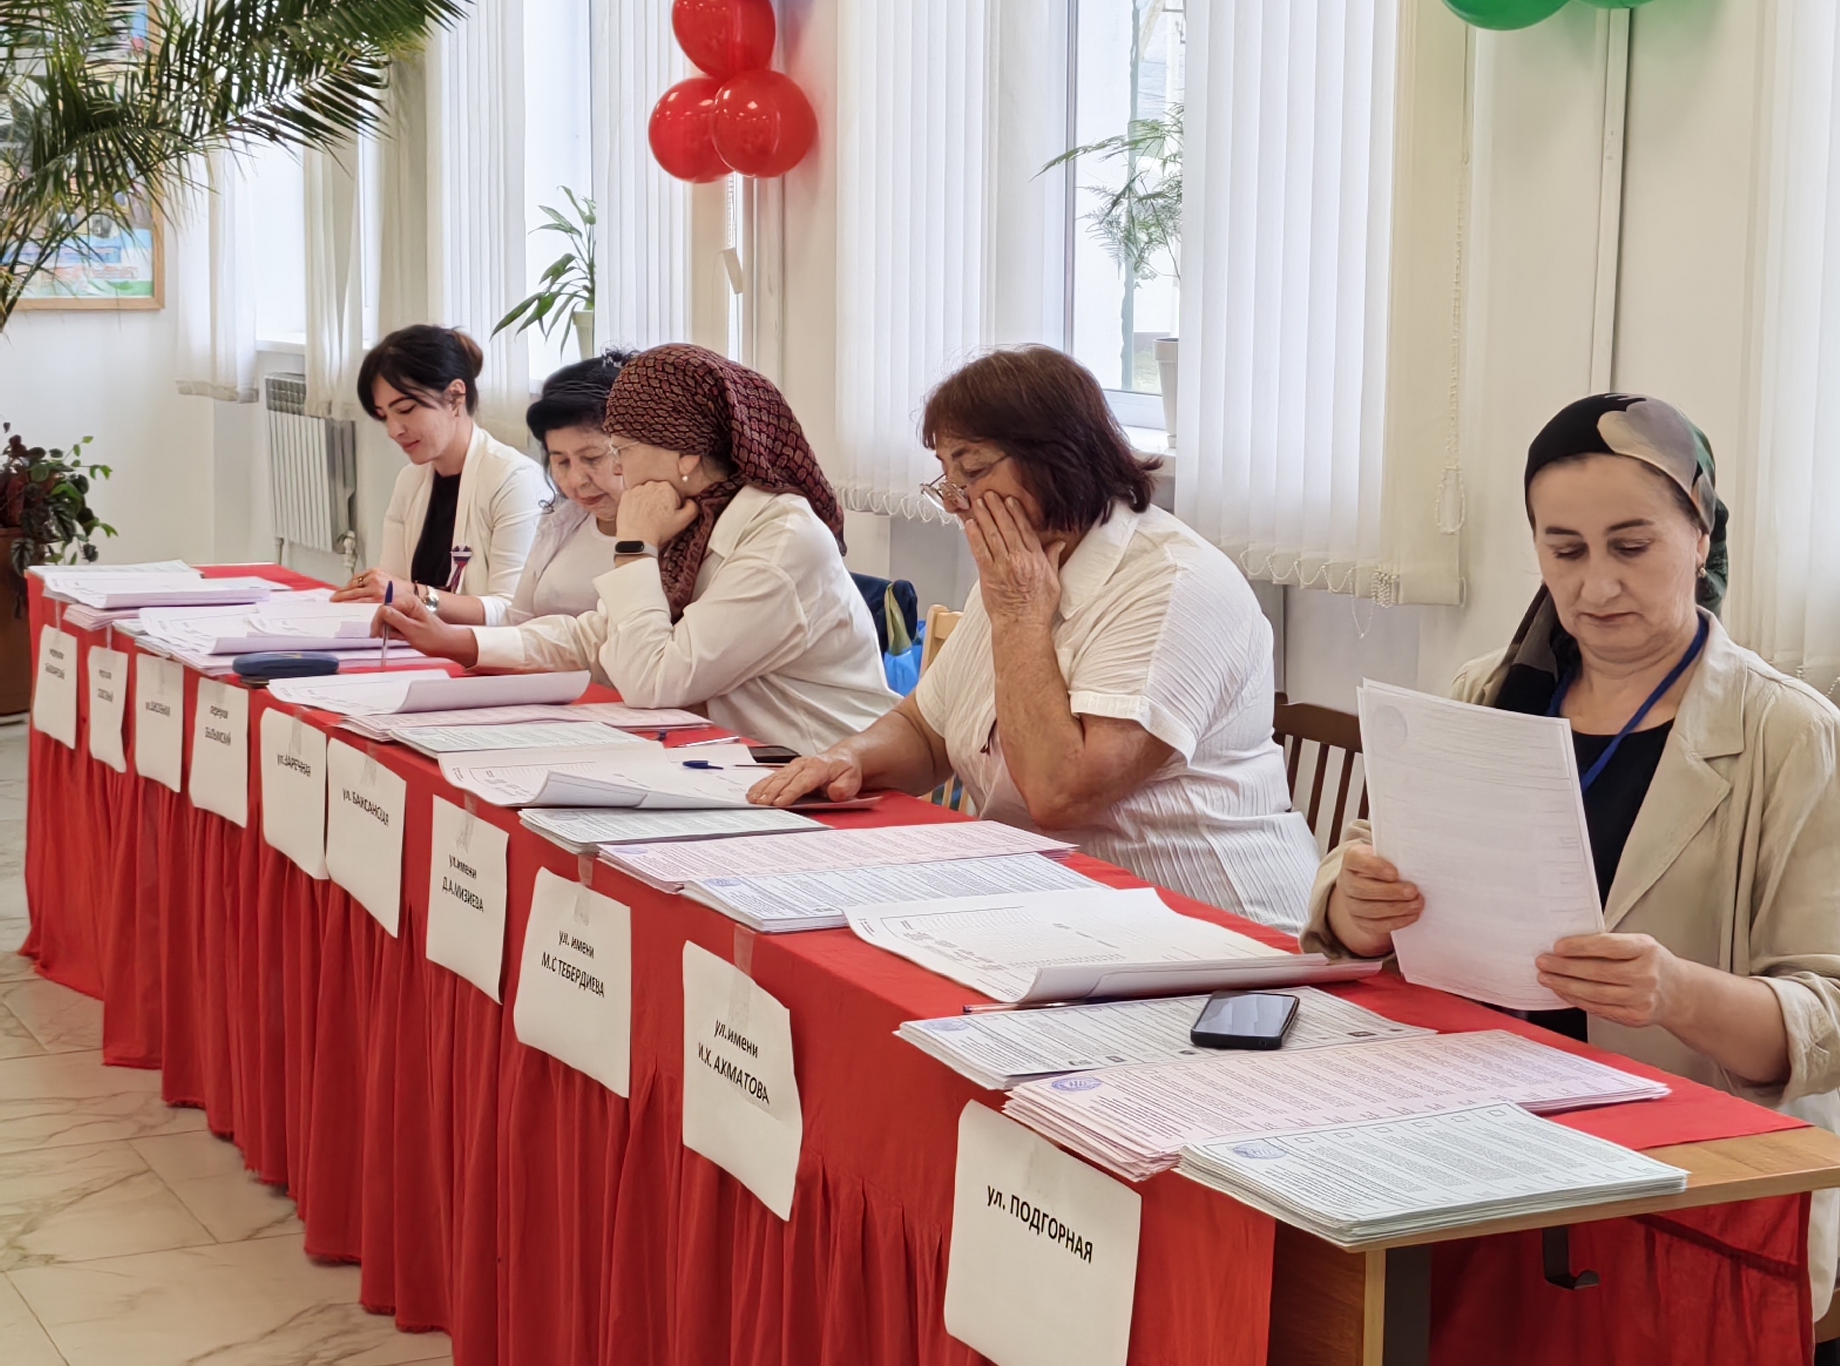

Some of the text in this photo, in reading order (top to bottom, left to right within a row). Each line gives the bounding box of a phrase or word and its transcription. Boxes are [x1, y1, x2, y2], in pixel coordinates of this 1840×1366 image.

[570, 936, 595, 960] имени
[713, 1055, 770, 1105] АХМАТОВА
[987, 1185, 1093, 1264] ул. ПОДГОРНАЯ
